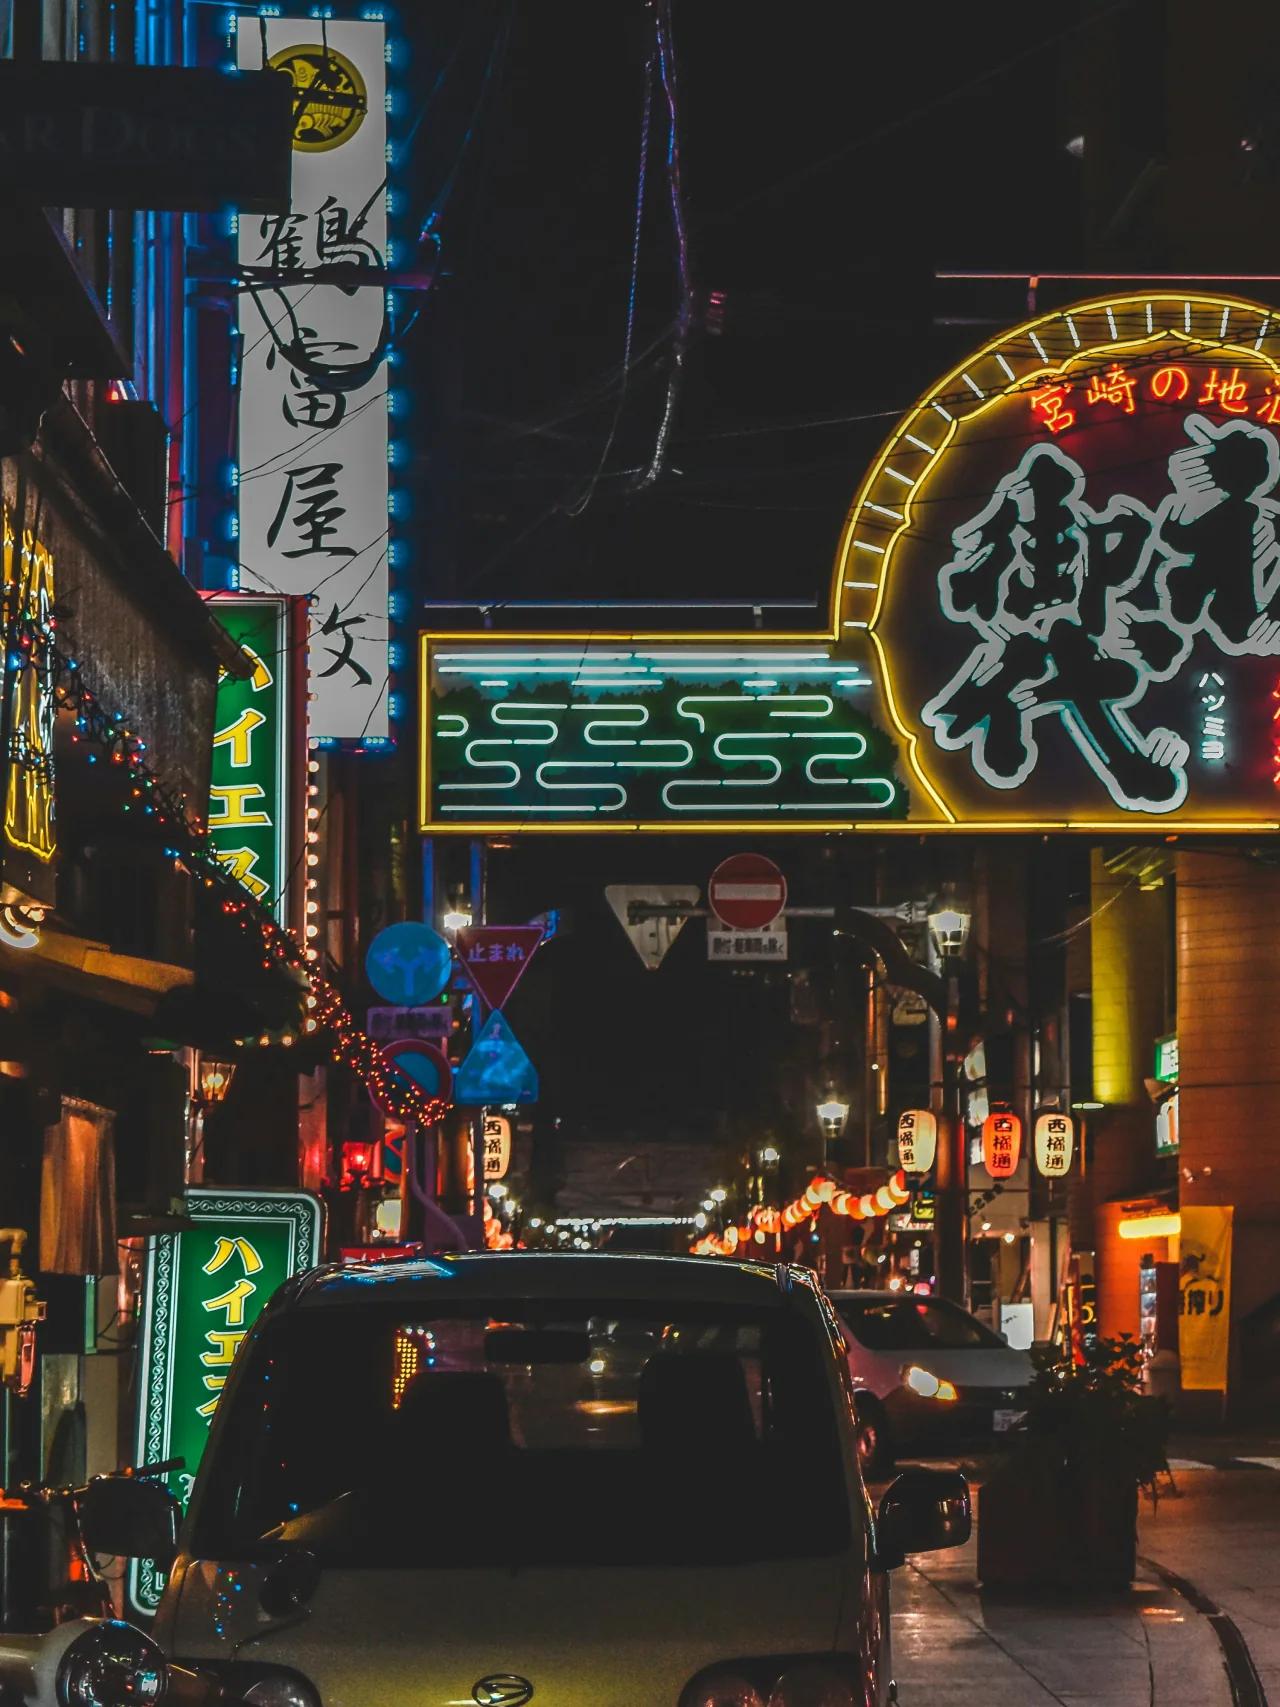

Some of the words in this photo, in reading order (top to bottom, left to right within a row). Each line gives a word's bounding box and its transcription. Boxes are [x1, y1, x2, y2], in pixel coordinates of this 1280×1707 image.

[1199, 672, 1226, 759] ハツミヨ
[467, 942, 525, 962] 止まれ
